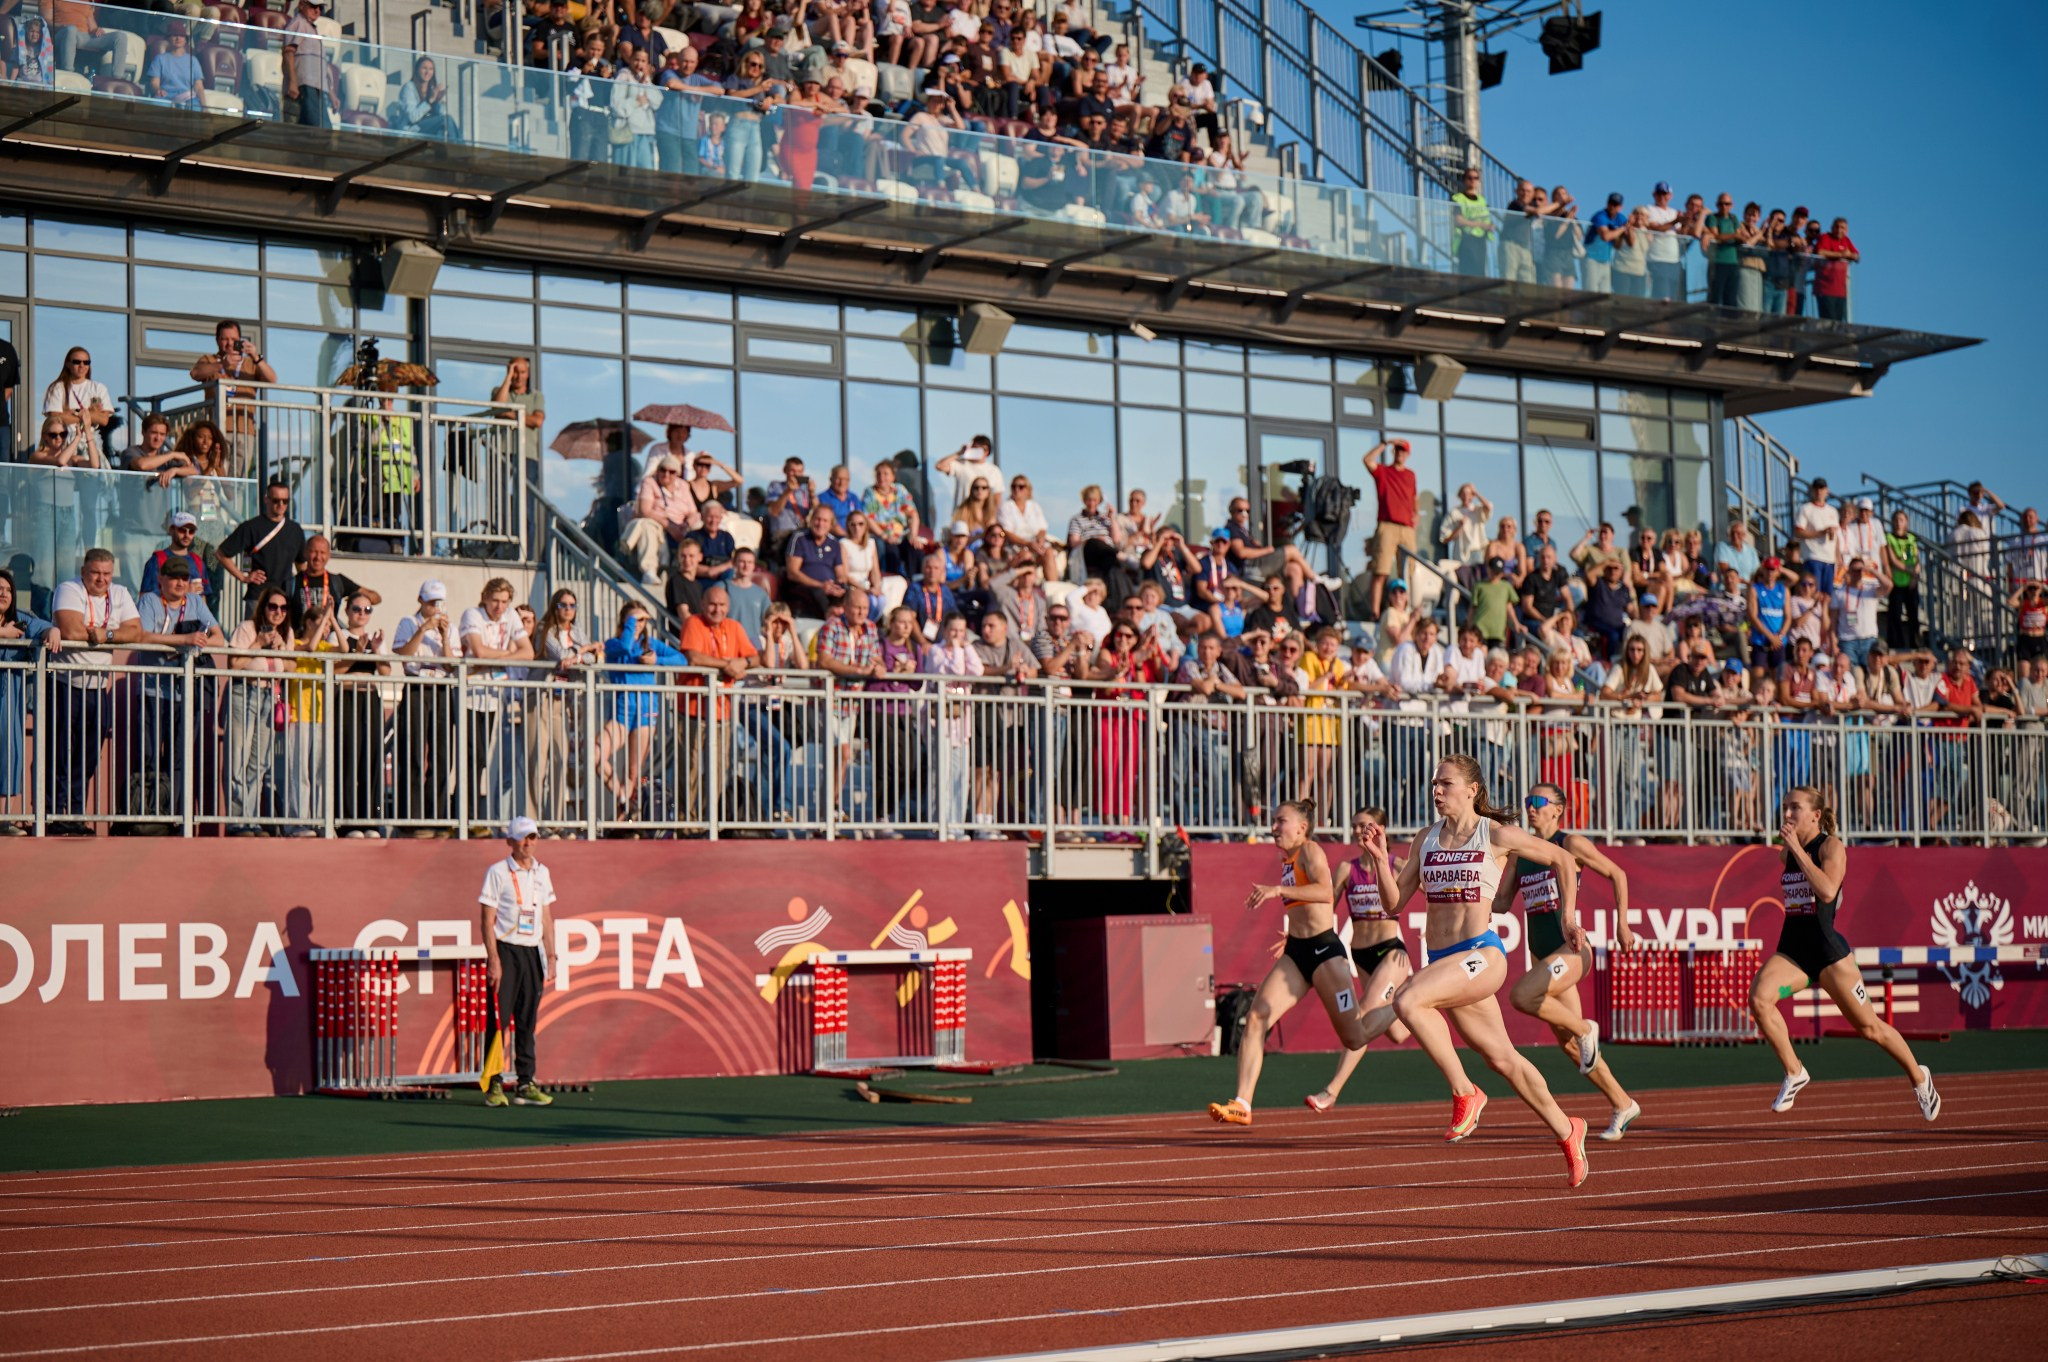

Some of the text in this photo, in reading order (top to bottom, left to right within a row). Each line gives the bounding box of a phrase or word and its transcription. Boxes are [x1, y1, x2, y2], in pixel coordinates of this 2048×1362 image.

[1430, 852, 1478, 862] FONBET
[1424, 869, 1480, 882] КАРАВАЕВА
[1520, 870, 1551, 885] FONBET
[353, 917, 705, 997] СПРТА
[1385, 986, 1394, 999] 8
[1856, 985, 1865, 999] 5
[1339, 993, 1348, 1008] 7
